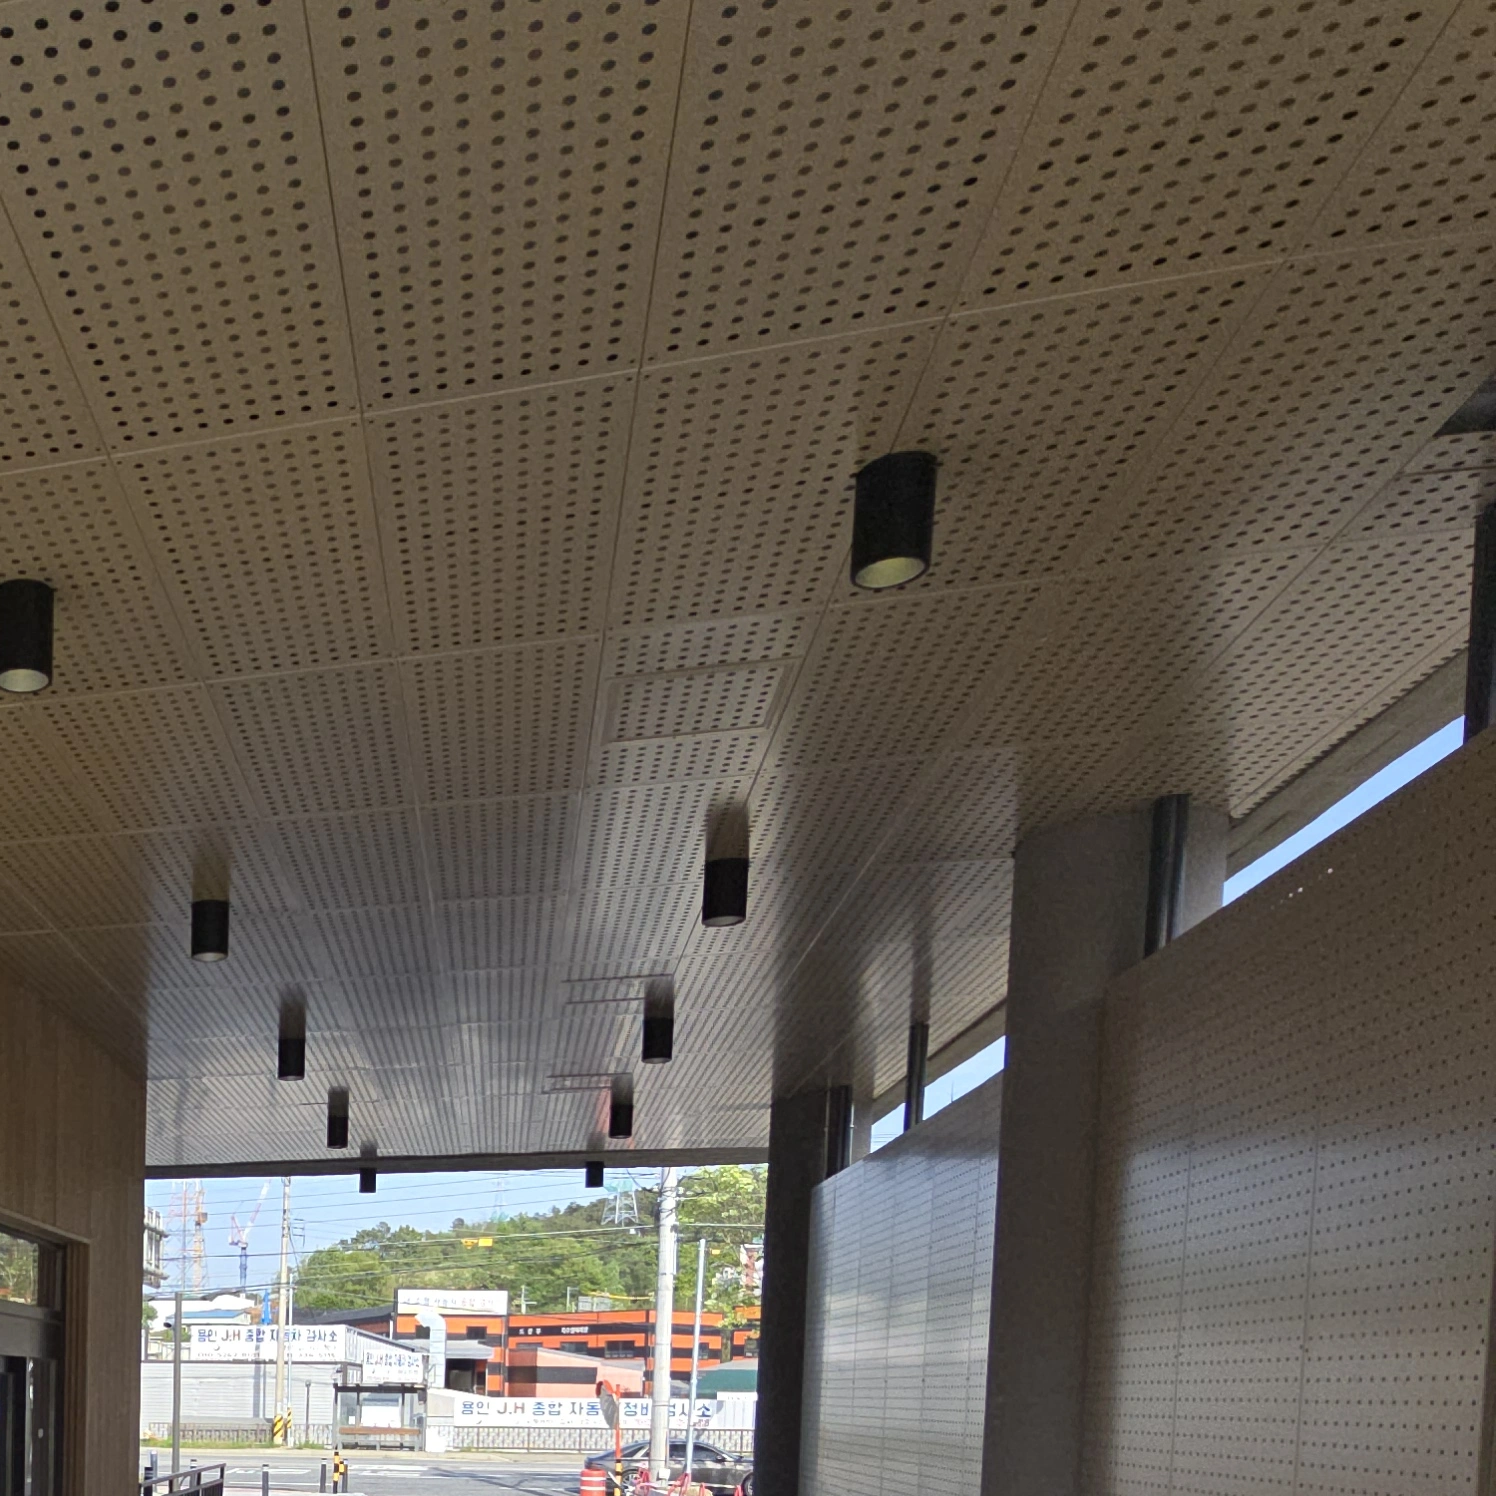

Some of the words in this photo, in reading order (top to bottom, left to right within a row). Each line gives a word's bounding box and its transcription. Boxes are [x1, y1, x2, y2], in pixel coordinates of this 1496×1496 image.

[198, 1329, 217, 1343] 용인
[245, 1328, 266, 1343] 종합
[306, 1329, 338, 1343] 검사소
[461, 1401, 489, 1415] 용인
[497, 1402, 525, 1414] J.H
[532, 1401, 562, 1416] 종합
[569, 1401, 600, 1416] 자동
